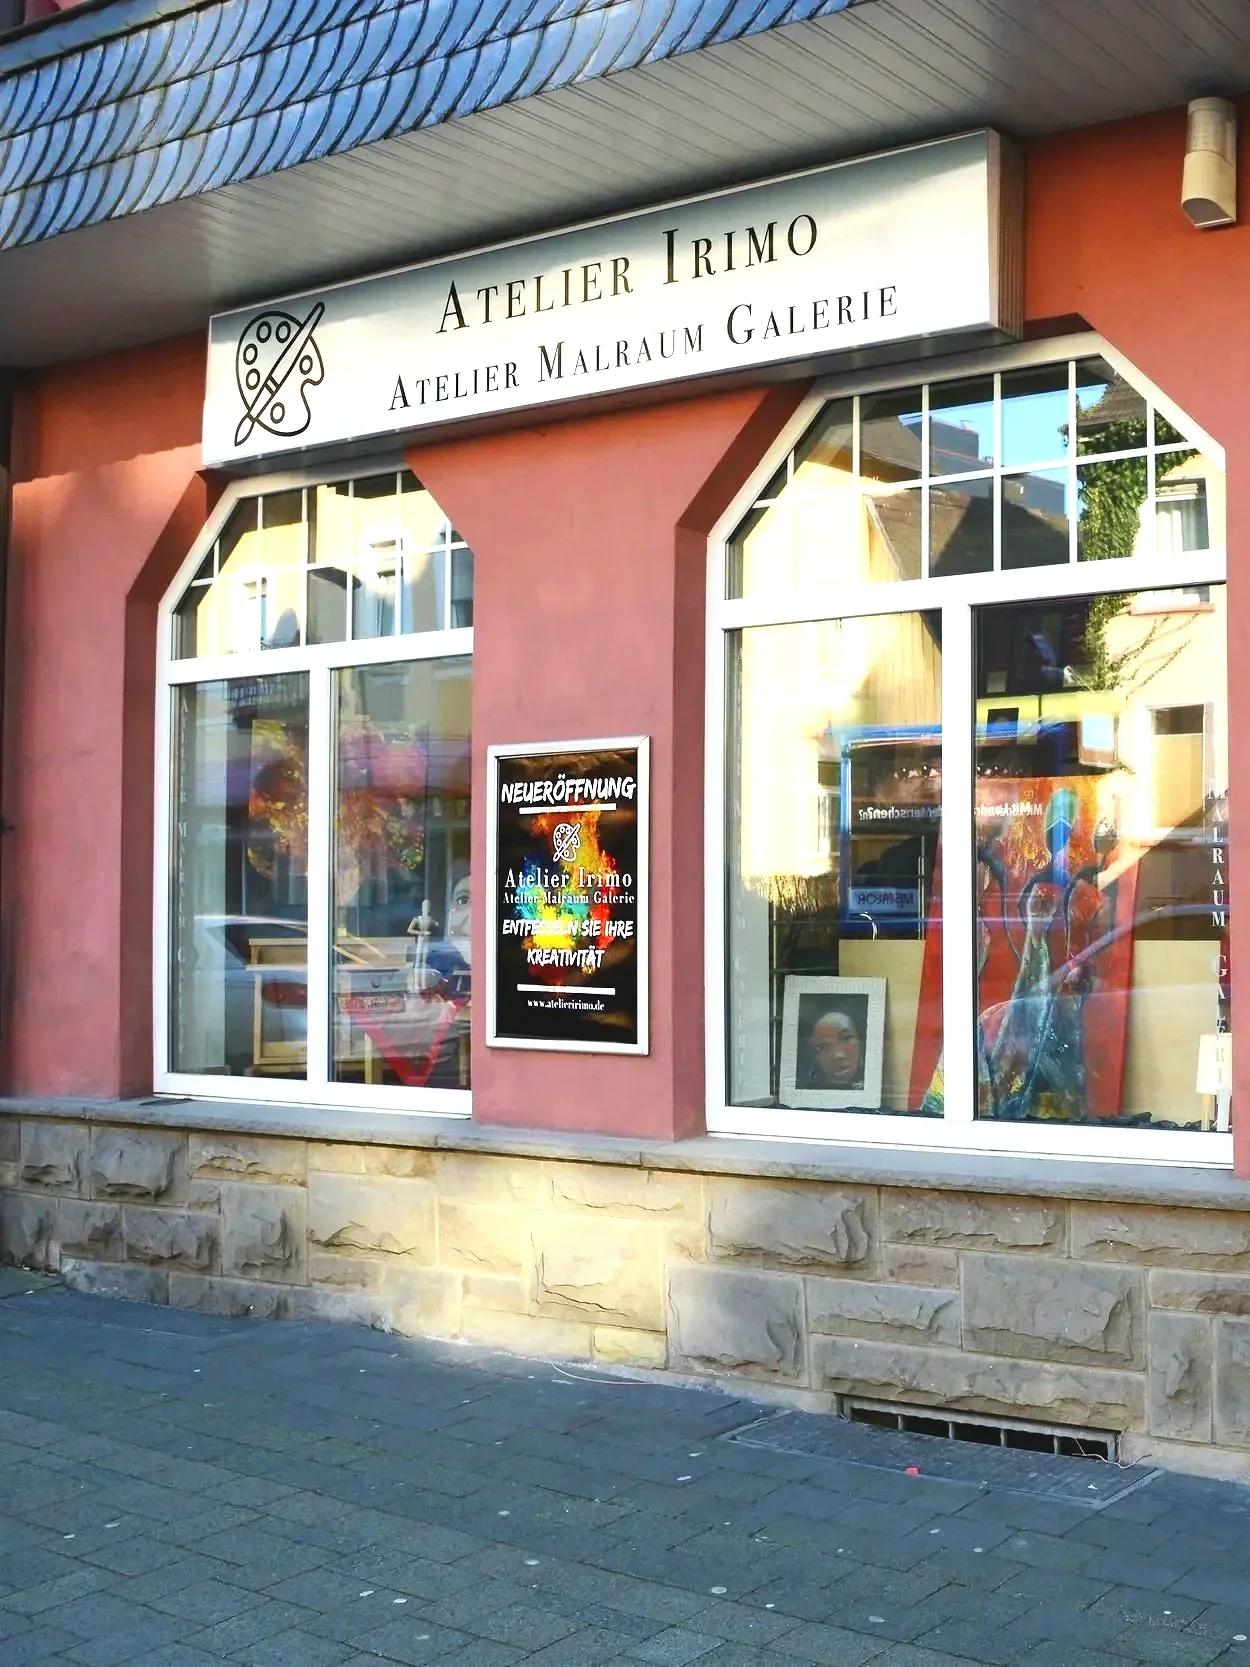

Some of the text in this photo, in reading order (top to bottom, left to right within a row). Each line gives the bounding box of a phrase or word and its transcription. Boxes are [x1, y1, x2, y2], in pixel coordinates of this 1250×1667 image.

[436, 213, 819, 333] ATELIER IRIMO
[388, 285, 899, 411] ATELIER MALRAUM GALERIE
[501, 774, 636, 804] NEUERÖFFNUNG
[1208, 784, 1229, 927] MALRAUM
[505, 865, 632, 888] Atelier Irimo
[502, 890, 635, 905] Atelier Malraum Galerie
[581, 920, 601, 937] SIE
[604, 920, 633, 938] IHRE
[527, 945, 605, 968] KREATIVITÄT
[527, 998, 605, 1012] www.atelieririmo.de
